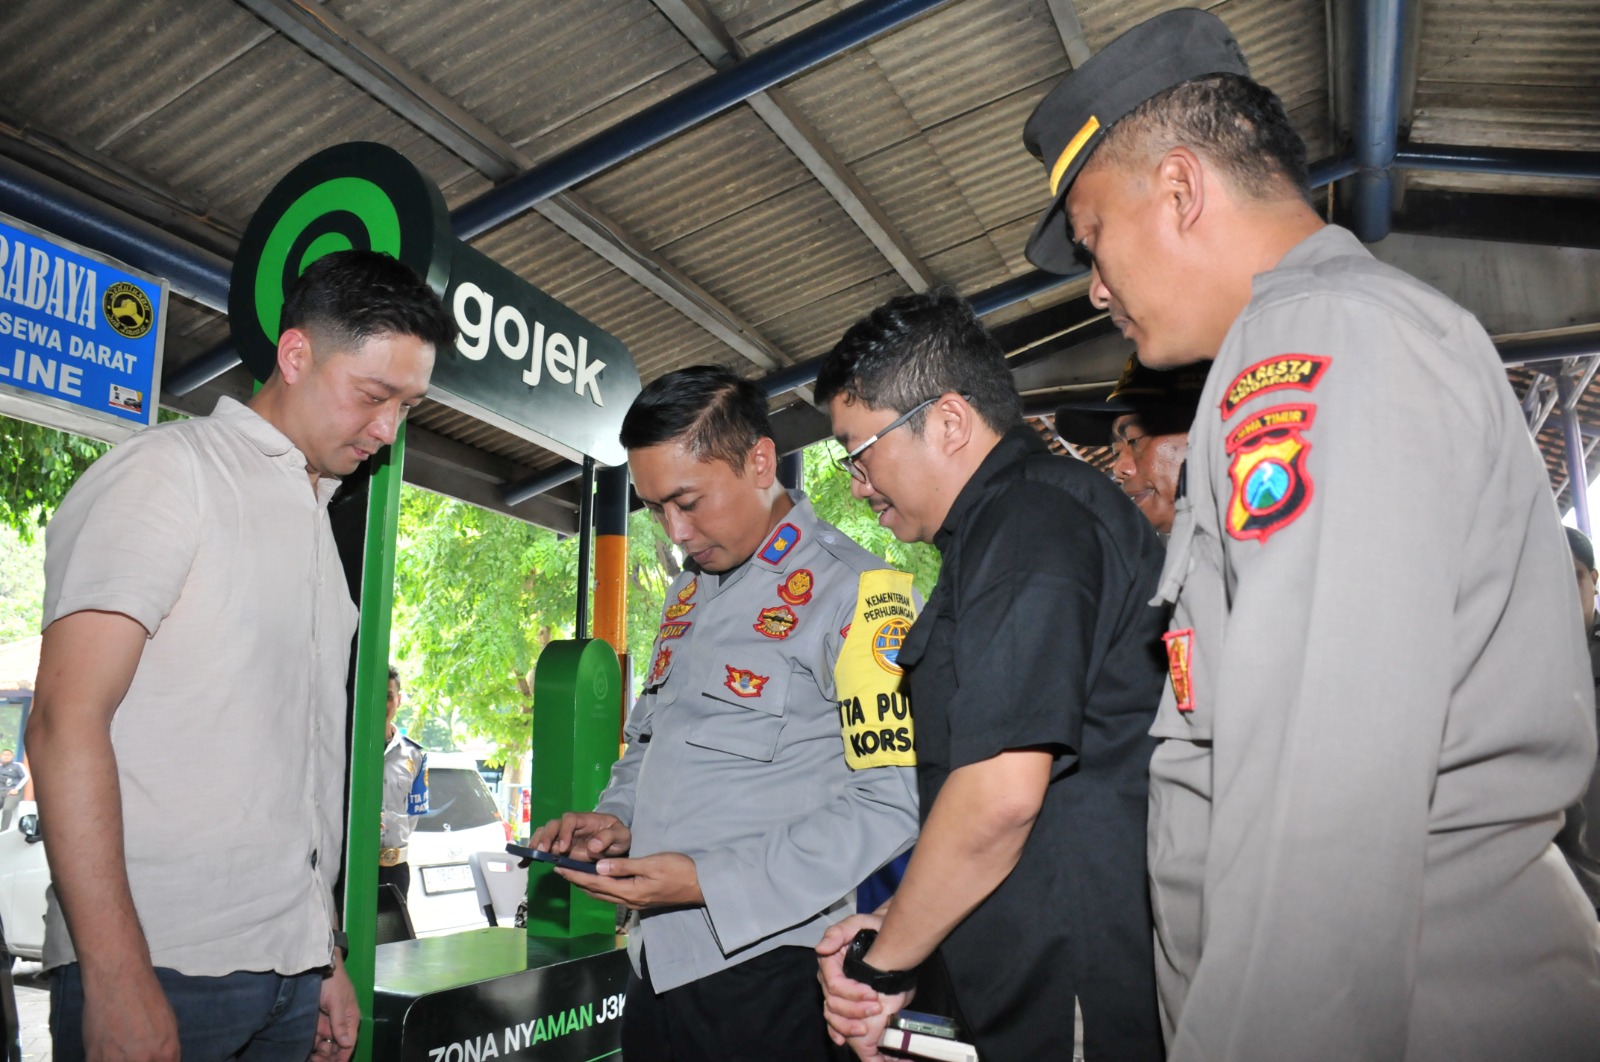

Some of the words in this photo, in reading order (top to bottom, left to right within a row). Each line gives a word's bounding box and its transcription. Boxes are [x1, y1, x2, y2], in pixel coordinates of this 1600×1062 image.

[0, 312, 62, 352] SEWA
[69, 335, 137, 375] DARAT
[453, 282, 607, 407] gojek
[864, 605, 915, 623] PERHUBUNGAN
[865, 592, 911, 608] KEMENTERIAN
[877, 692, 914, 722] PU
[850, 727, 916, 758] KORS
[428, 1032, 499, 1062] ZONA
[504, 1002, 593, 1055] NYAMAN
